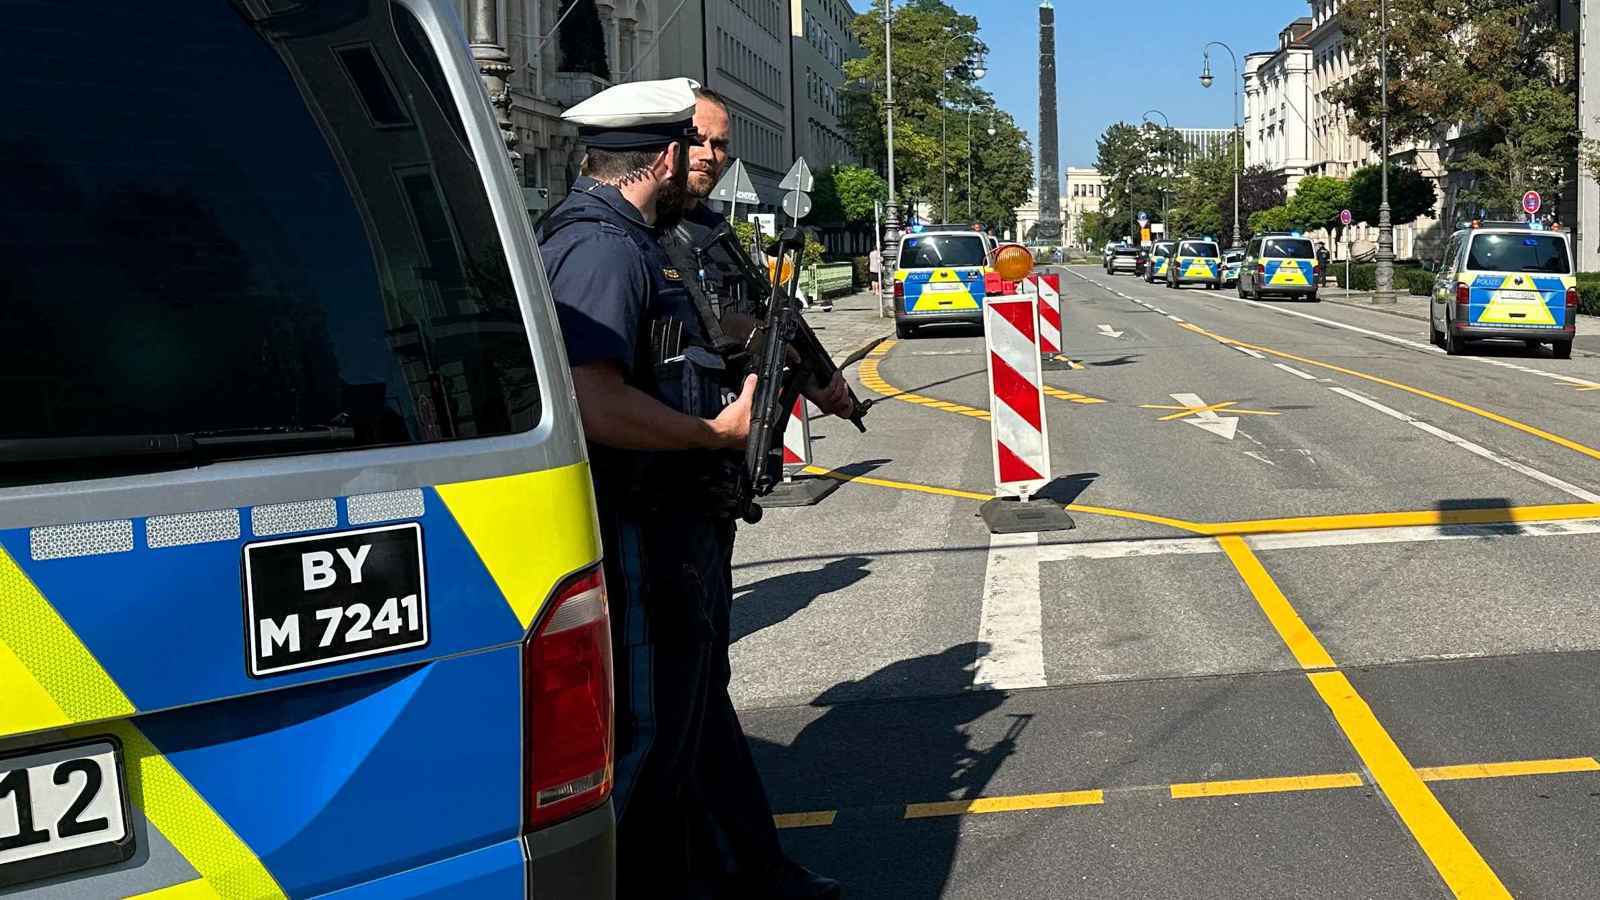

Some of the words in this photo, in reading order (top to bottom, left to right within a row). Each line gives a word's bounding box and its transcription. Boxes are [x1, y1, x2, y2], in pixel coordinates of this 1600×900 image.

[302, 544, 372, 591] BY
[259, 613, 301, 658] M
[315, 594, 419, 648] 7241
[0, 758, 109, 852] 12
